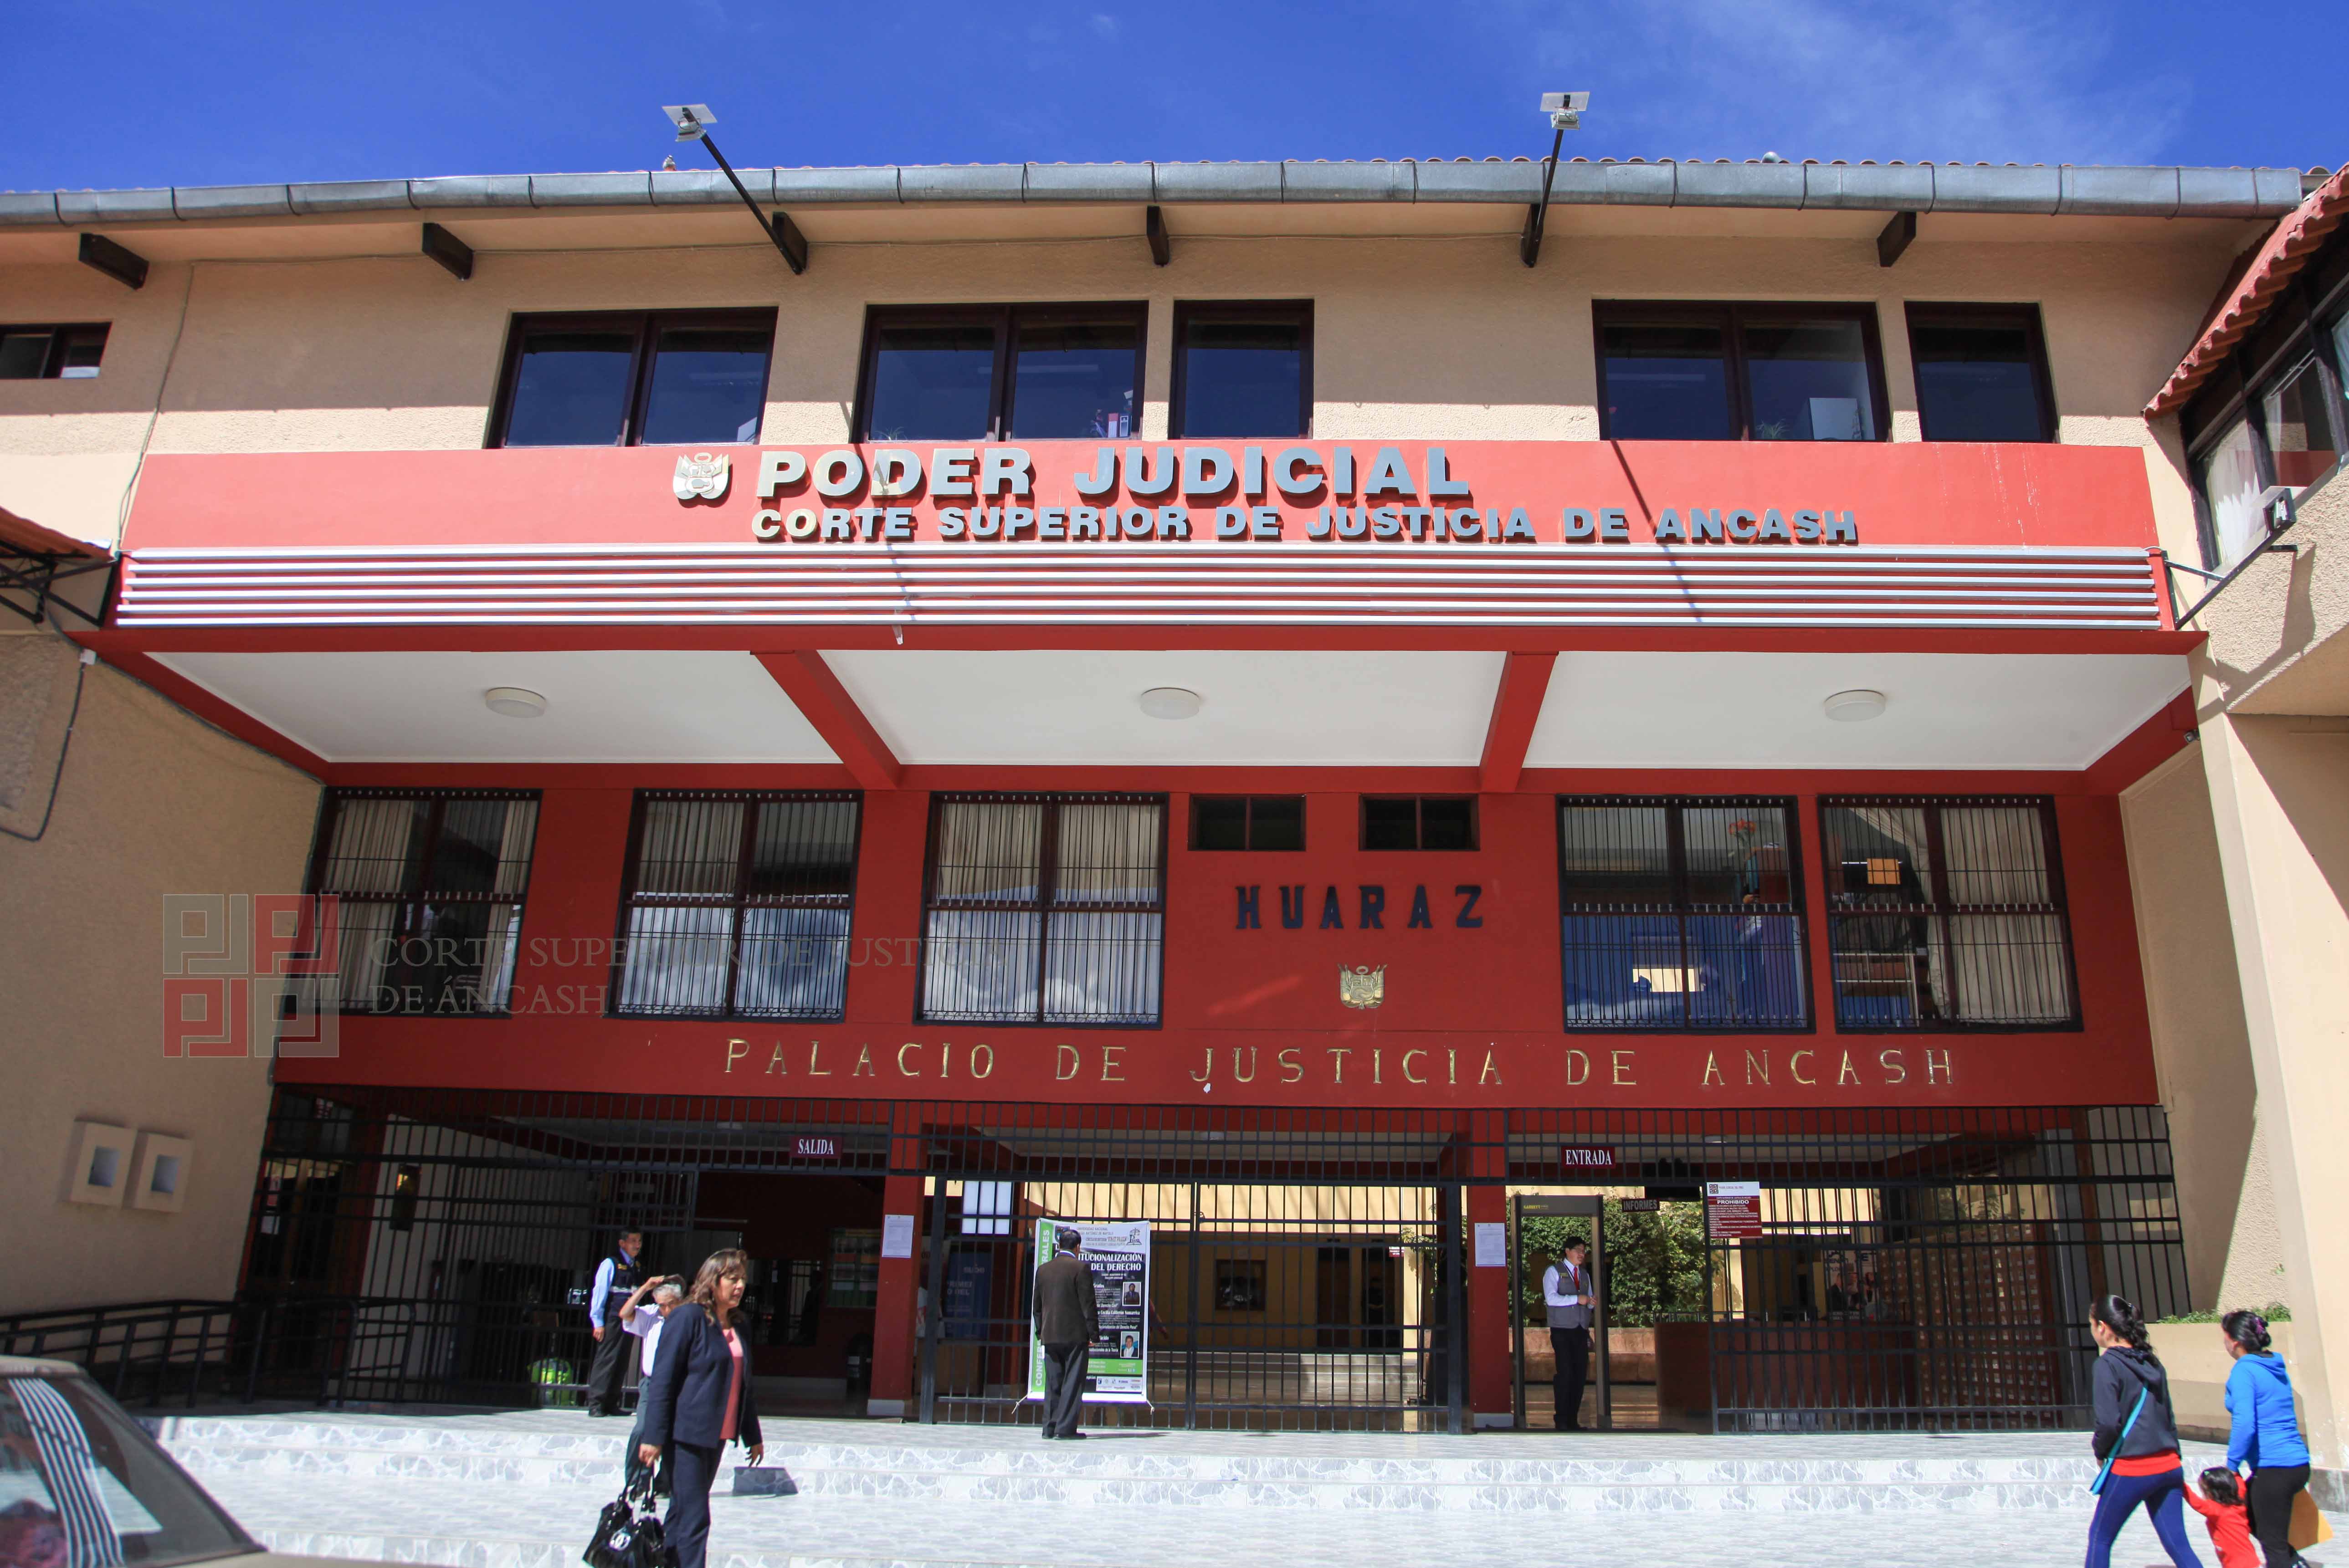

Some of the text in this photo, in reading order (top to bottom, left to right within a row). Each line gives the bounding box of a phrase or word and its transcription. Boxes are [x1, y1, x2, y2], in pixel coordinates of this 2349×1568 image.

[756, 446, 1469, 498] PODER JUDICIAL
[751, 506, 1857, 543] CORTE SUPERIOR DE JUSTICIA DE ANCASH
[1236, 885, 1483, 930] HUARAZ
[725, 1039, 1954, 1086] PALACIO DE JUSTICIA DE ANCASH
[798, 1138, 834, 1155] SALIDA
[1565, 1149, 1612, 1166] ENTRADA
[1623, 1199, 1657, 1211] INFORMES
[1041, 1230, 1050, 1263] RALES
[1078, 1252, 1143, 1261] ITUCIONALIZACIÓN
[1091, 1263, 1141, 1271] DEL DERECHO
